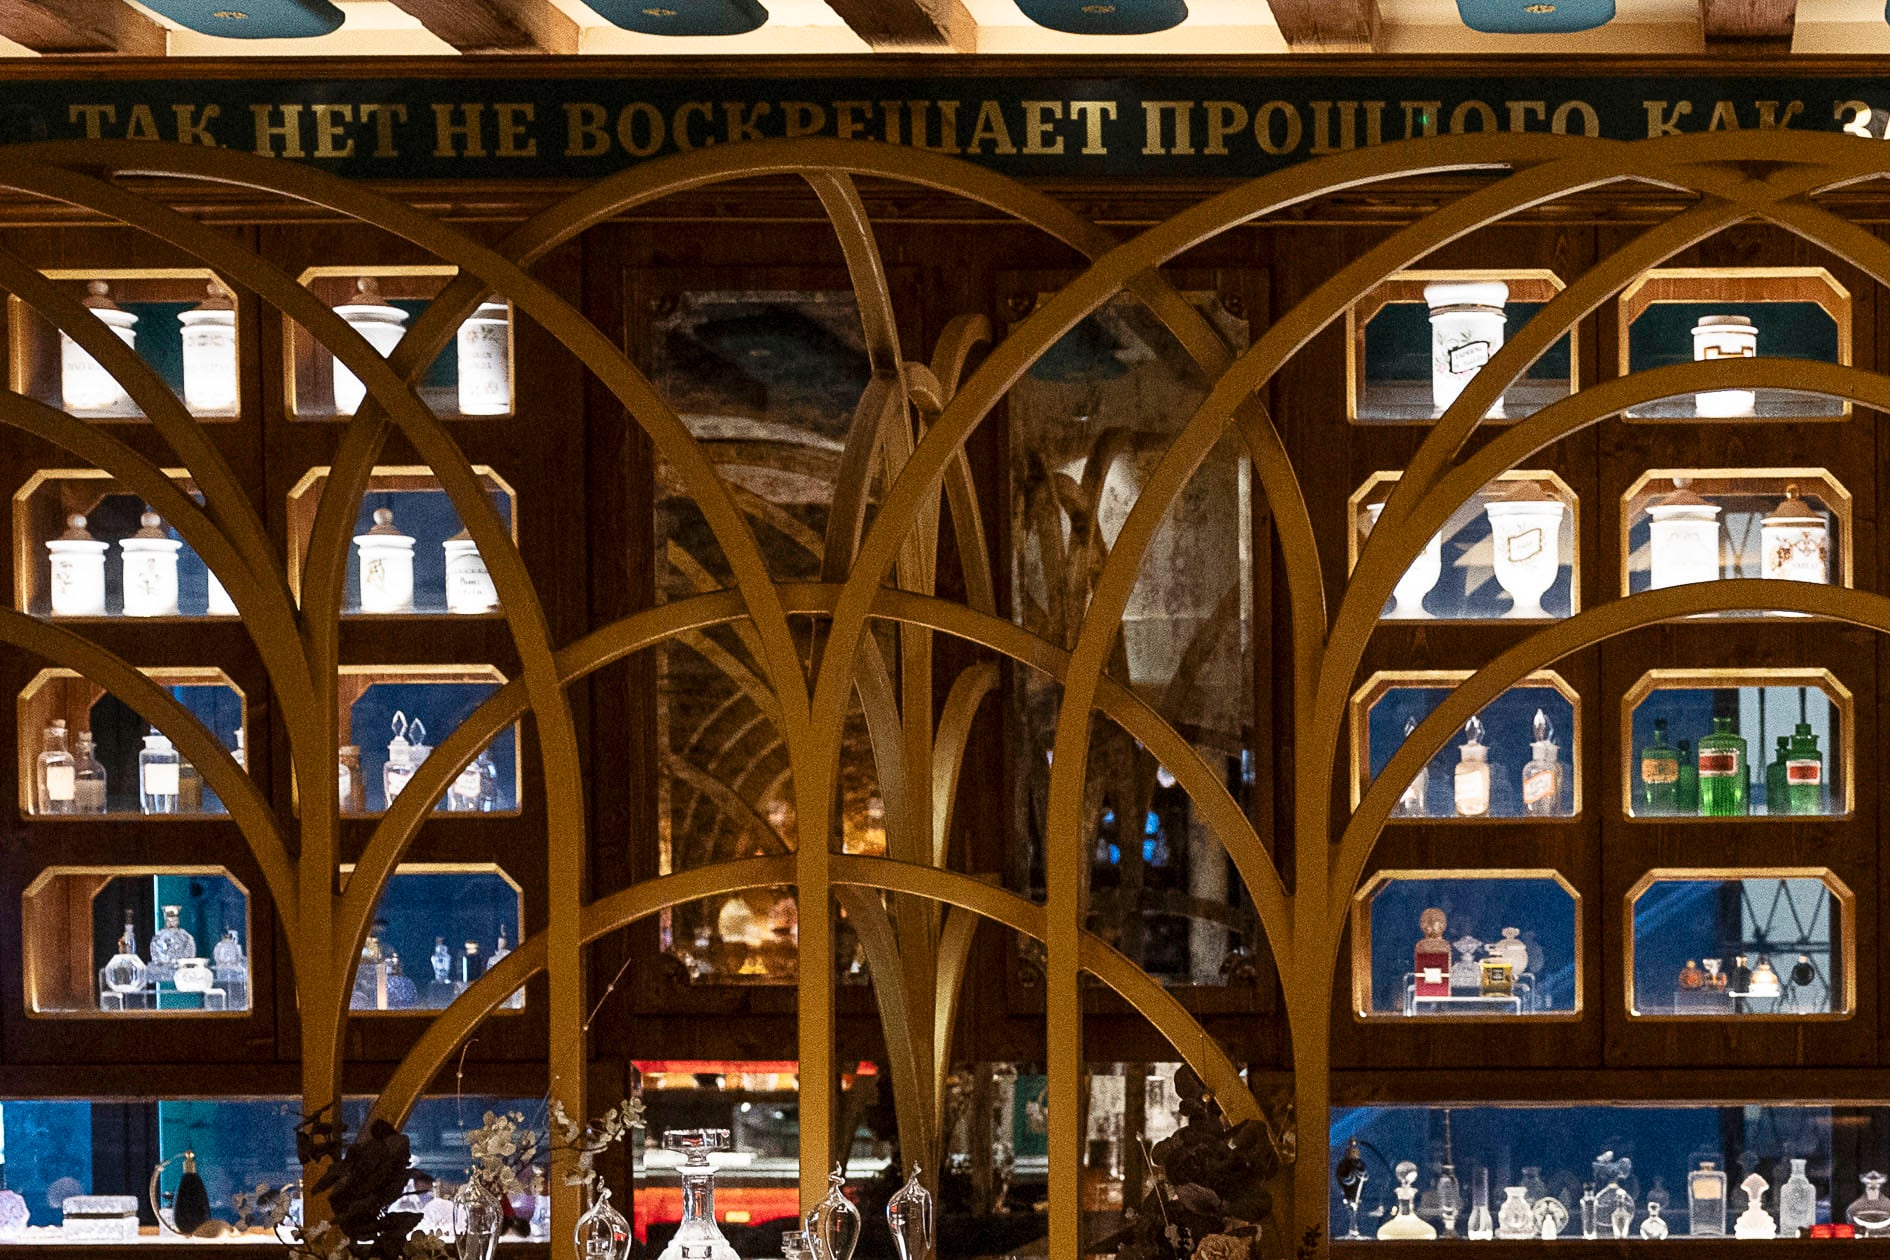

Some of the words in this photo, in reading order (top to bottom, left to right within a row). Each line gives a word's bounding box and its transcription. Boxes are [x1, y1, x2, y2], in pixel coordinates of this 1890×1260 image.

[68, 102, 229, 149] ТАК
[248, 102, 408, 159] НЕТ
[431, 101, 538, 159] НЕ
[1140, 100, 1601, 156] ПРОШЛОГО
